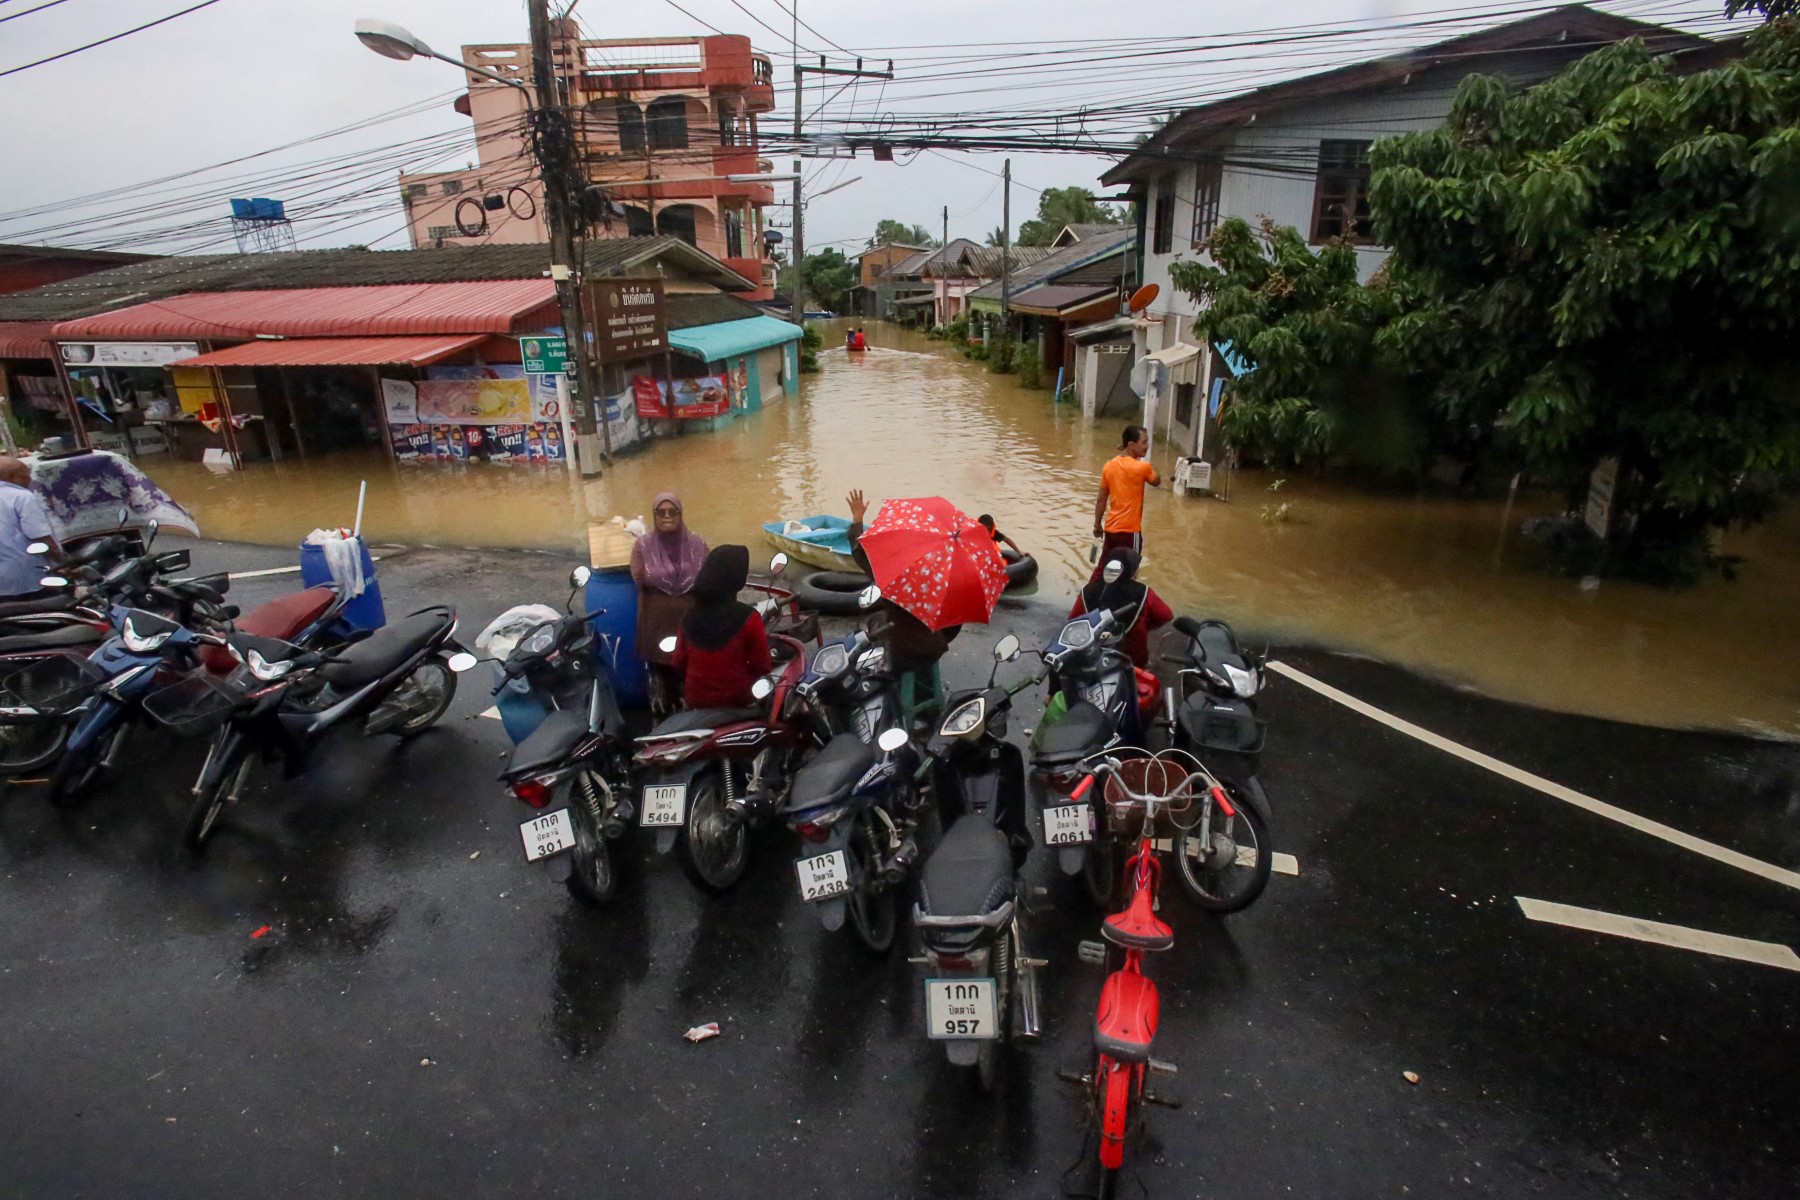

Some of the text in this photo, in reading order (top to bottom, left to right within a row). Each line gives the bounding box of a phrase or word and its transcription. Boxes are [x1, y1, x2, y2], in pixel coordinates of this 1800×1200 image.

[655, 788, 677, 799] 1กก
[647, 812, 678, 823] 5494
[1051, 830, 1085, 843] 4061
[537, 838, 563, 856] 301
[807, 854, 835, 871] 1กจ
[807, 880, 845, 898] 2438
[944, 984, 979, 1000] 1กก
[945, 1019, 980, 1034] 957
